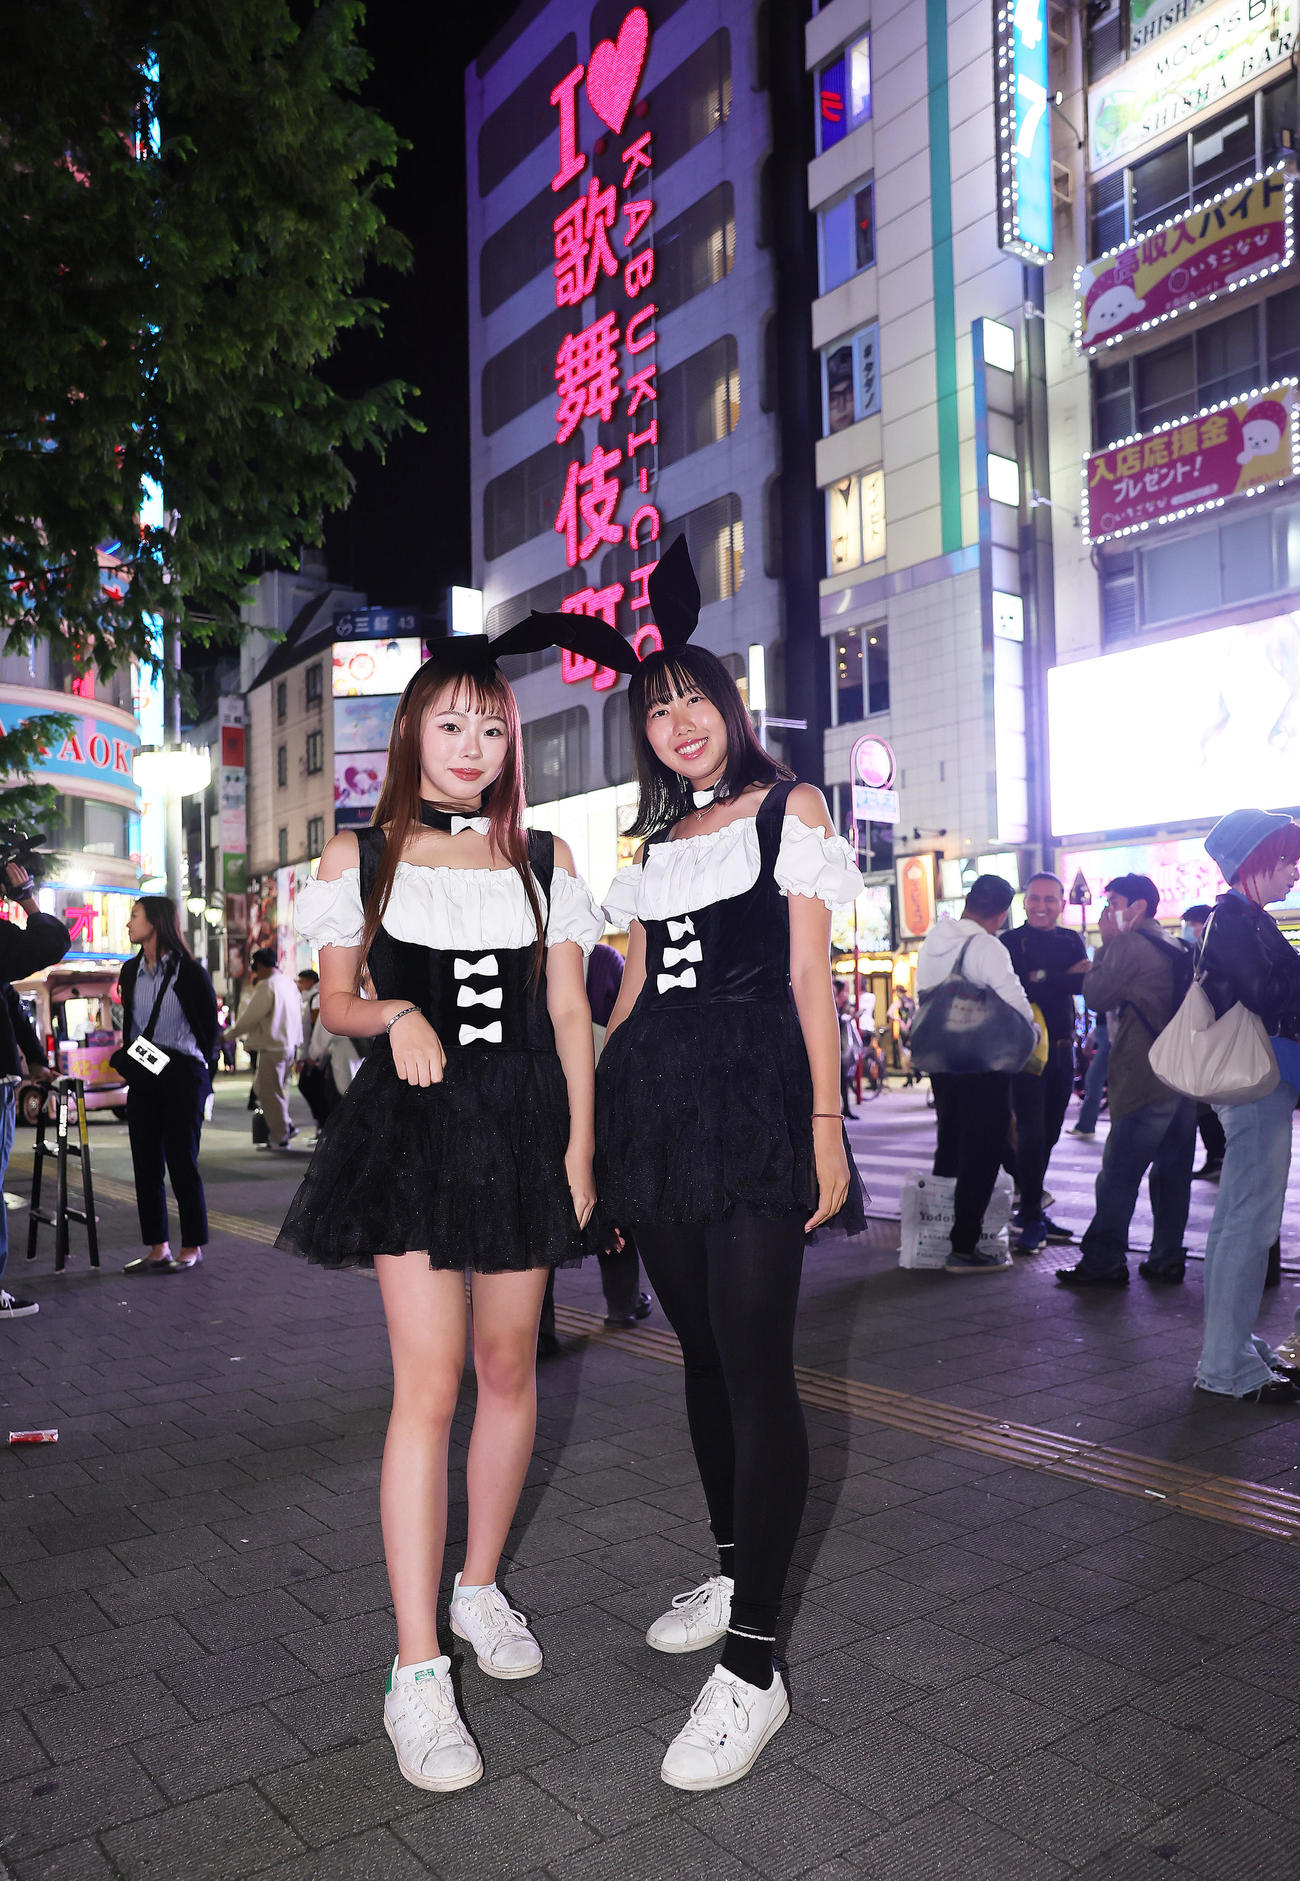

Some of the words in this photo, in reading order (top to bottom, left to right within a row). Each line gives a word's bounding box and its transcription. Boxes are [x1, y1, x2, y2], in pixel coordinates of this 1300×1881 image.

[1142, 75, 1227, 138] SHISHA
[1241, 32, 1292, 78] BAR
[1113, 177, 1284, 283] 高収入バイト
[1090, 415, 1229, 488] 入店応援金
